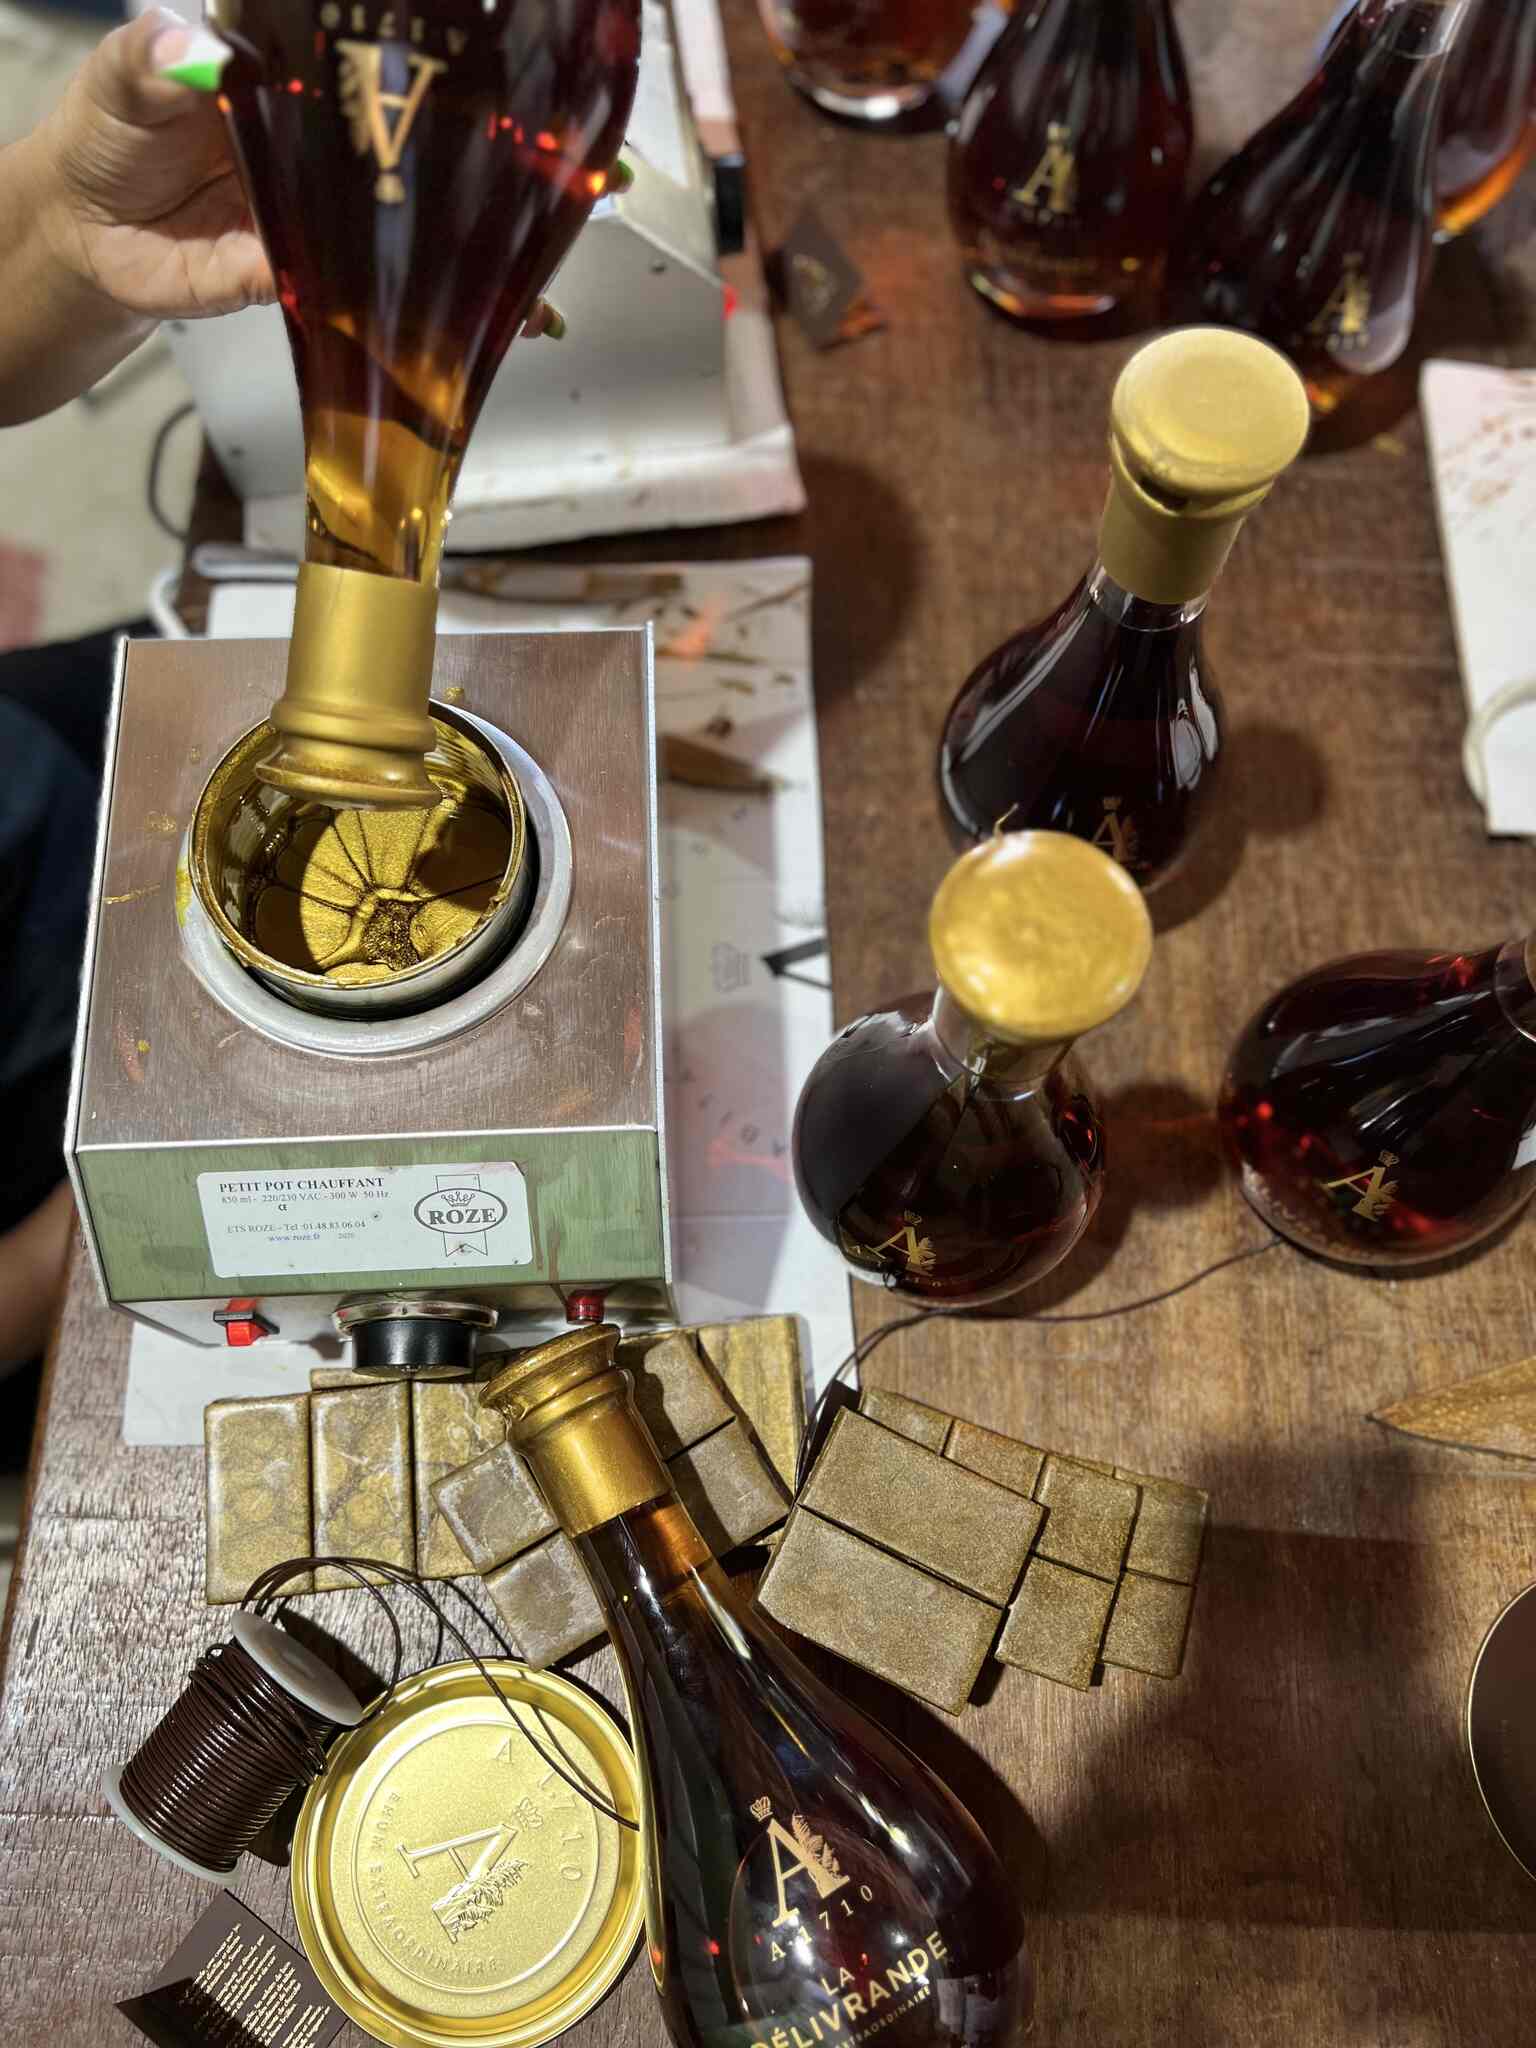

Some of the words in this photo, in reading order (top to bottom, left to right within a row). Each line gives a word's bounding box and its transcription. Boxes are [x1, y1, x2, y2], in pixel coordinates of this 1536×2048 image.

[219, 1182, 262, 1193] PETIT
[265, 1181, 294, 1192] POT
[297, 1177, 385, 1190] CHAUFFANT
[428, 1207, 497, 1227] ROZE
[765, 1817, 850, 1929] A
[819, 1966, 856, 1998] LA
